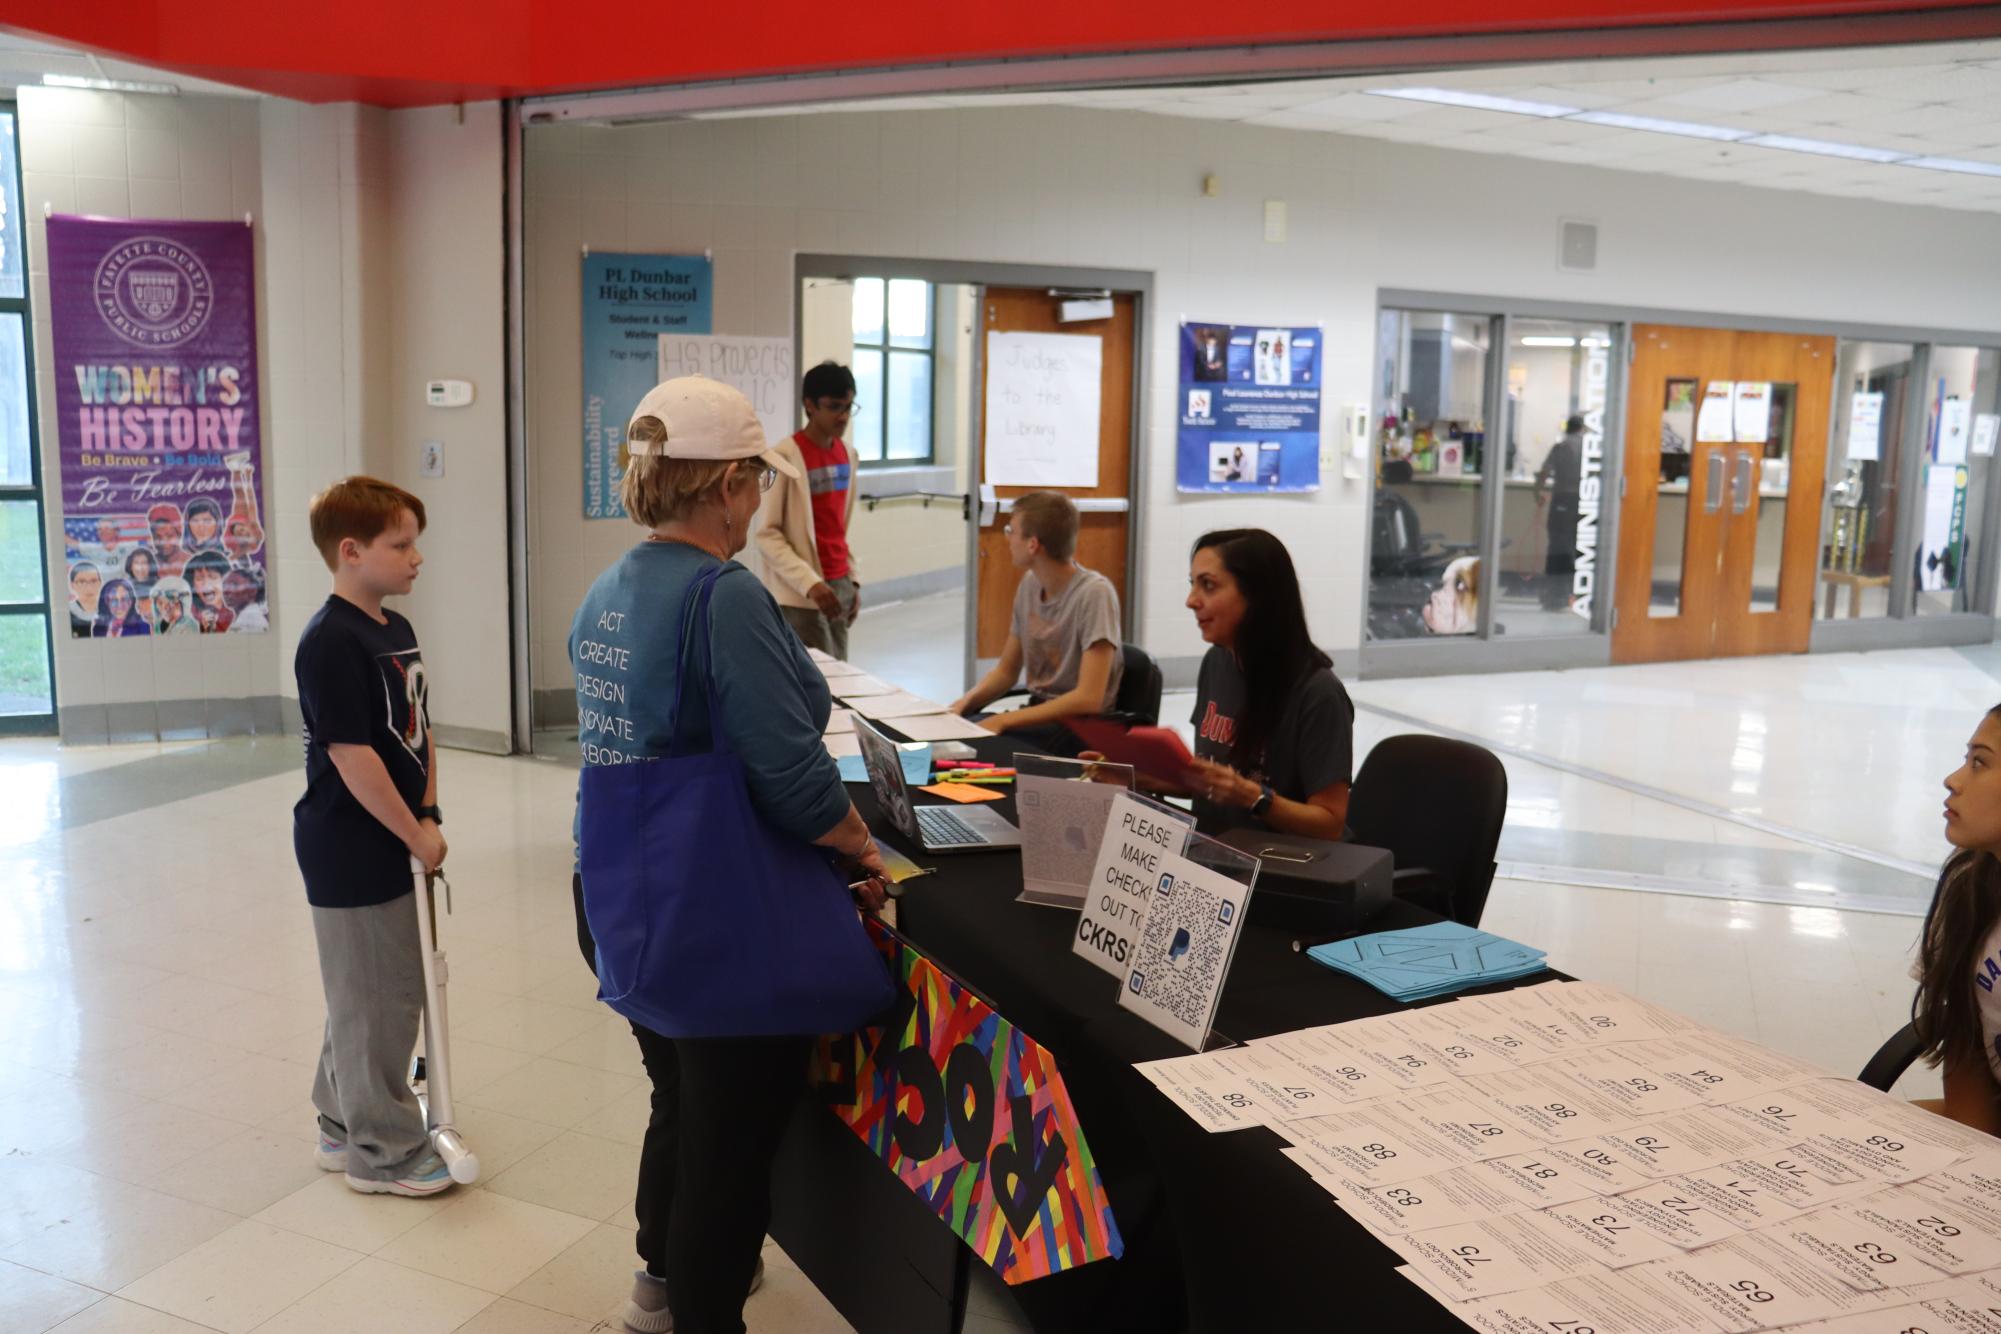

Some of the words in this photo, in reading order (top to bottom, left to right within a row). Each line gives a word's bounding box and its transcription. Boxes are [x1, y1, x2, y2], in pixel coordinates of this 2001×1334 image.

[158, 243, 205, 290] COUNTY
[605, 268, 626, 283] PL
[630, 268, 691, 285] Dunbar
[599, 285, 639, 303] High
[642, 286, 697, 302] School
[625, 330, 658, 340] Wellne
[74, 364, 242, 406] WOMEN'S
[79, 406, 245, 451] HISTORY
[1005, 418, 1055, 447] Library
[81, 454, 101, 466] Be
[105, 454, 149, 466] Brave
[585, 396, 604, 517] Sustainability
[605, 426, 619, 516] Scorecard
[1571, 331, 1610, 621] ADMINISTRATION
[79, 476, 118, 507] Be
[130, 467, 226, 501] Fearless
[597, 609, 625, 633] ACT
[578, 640, 631, 671] CREATE
[577, 673, 625, 705] DESIGN
[578, 709, 634, 741] NOVATE
[1123, 813, 1172, 848] PLEASE
[1121, 843, 1158, 873] MAKE
[1101, 895, 1127, 920] OUT
[1976, 950, 2001, 992] DA
[1590, 1015, 1616, 1030] 90
[1492, 1034, 1523, 1048] 92
[1397, 1054, 1428, 1068] 94
[1445, 1045, 1474, 1059] 93
[1335, 1066, 1367, 1081] 96
[1690, 1069, 1722, 1084] 84
[1283, 1087, 1315, 1100] 97
[1625, 1078, 1659, 1092] 85
[1223, 1093, 1252, 1108] 98
[1544, 1103, 1578, 1118] 86
[1761, 1105, 1797, 1122] 76
[1468, 1123, 1504, 1137] 87
[1362, 1143, 1397, 1160] 88
[1635, 1136, 1670, 1154] 79
[1866, 1135, 1904, 1152] 68
[1583, 1149, 1618, 1166] 80
[1522, 1162, 1558, 1179] 81
[1775, 1160, 1808, 1178] 70
[1386, 1188, 1423, 1206] 83
[1726, 1181, 1757, 1197] 71
[1661, 1196, 1701, 1217] 72
[1592, 1215, 1630, 1235] 73
[1917, 1216, 1961, 1237] 62
[1451, 1245, 1492, 1267] 75
[1830, 1243, 1875, 1272] MATERIALS
[1854, 1242, 1897, 1264] 63
[1665, 1271, 1704, 1297] SCHOOL
[1729, 1280, 1775, 1303] 65
[1706, 1282, 1752, 1312] MATERIALS
[1495, 1309, 1528, 1331] STATICS
